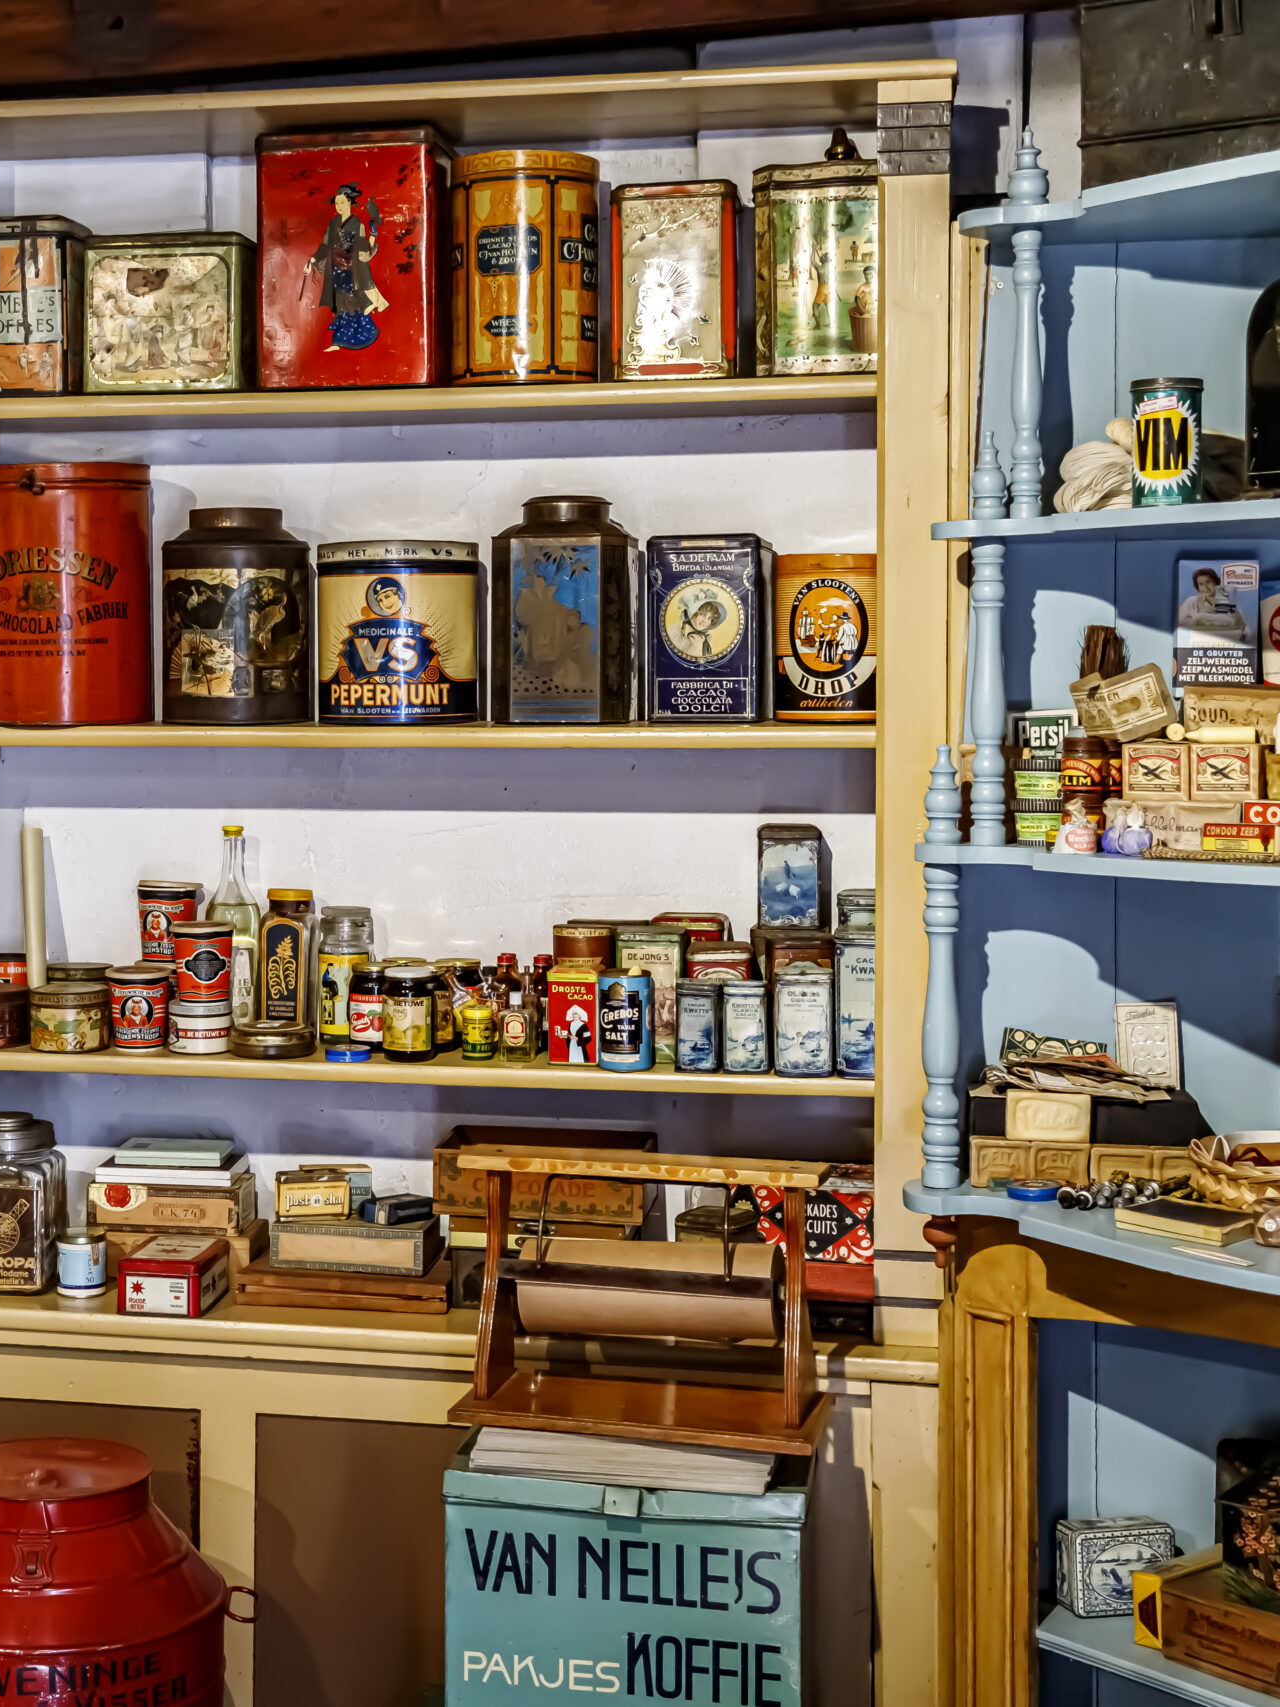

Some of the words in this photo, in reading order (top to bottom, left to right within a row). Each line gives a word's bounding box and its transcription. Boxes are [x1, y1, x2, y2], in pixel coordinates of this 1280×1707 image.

[491, 318, 518, 327] WEES
[1135, 417, 1189, 471] VIM
[347, 548, 367, 558] HET
[384, 547, 418, 556] MERK
[690, 553, 705, 562] DE
[706, 553, 735, 562] FAAM
[672, 563, 701, 572] BREDA
[793, 586, 809, 605] VAN
[77, 602, 129, 626] FABRIEK
[359, 626, 414, 637] MEDICINALE
[354, 636, 419, 672] VS
[1186, 657, 1249, 666] ZELFWERKEND
[1181, 665, 1254, 674] ZEEPWASMIDDEL
[797, 671, 858, 696] DROP
[1178, 674, 1196, 682] MET
[1199, 674, 1256, 683] BLEEKMIDDEL
[671, 681, 720, 689] FABBRICA
[330, 682, 450, 706] PEPERMUNT
[677, 689, 727, 697] CACAO
[671, 696, 732, 704] CIOCCOLATA
[799, 696, 854, 708] artikelen
[678, 704, 726, 713] DOLCI
[1018, 719, 1069, 748] Persil
[1206, 826, 1238, 835] CONDOR
[1239, 827, 1260, 837] ZEEP
[551, 985, 587, 993] DROSTE
[567, 993, 594, 1001] CACAO
[600, 1008, 639, 1029] CEREBOS
[605, 1031, 628, 1041] SALT
[464, 1527, 557, 1597] VAN
[577, 1536, 781, 1614] NELLE'S
[463, 1650, 620, 1694] PAKJES
[626, 1631, 782, 1707] KOFFIE
